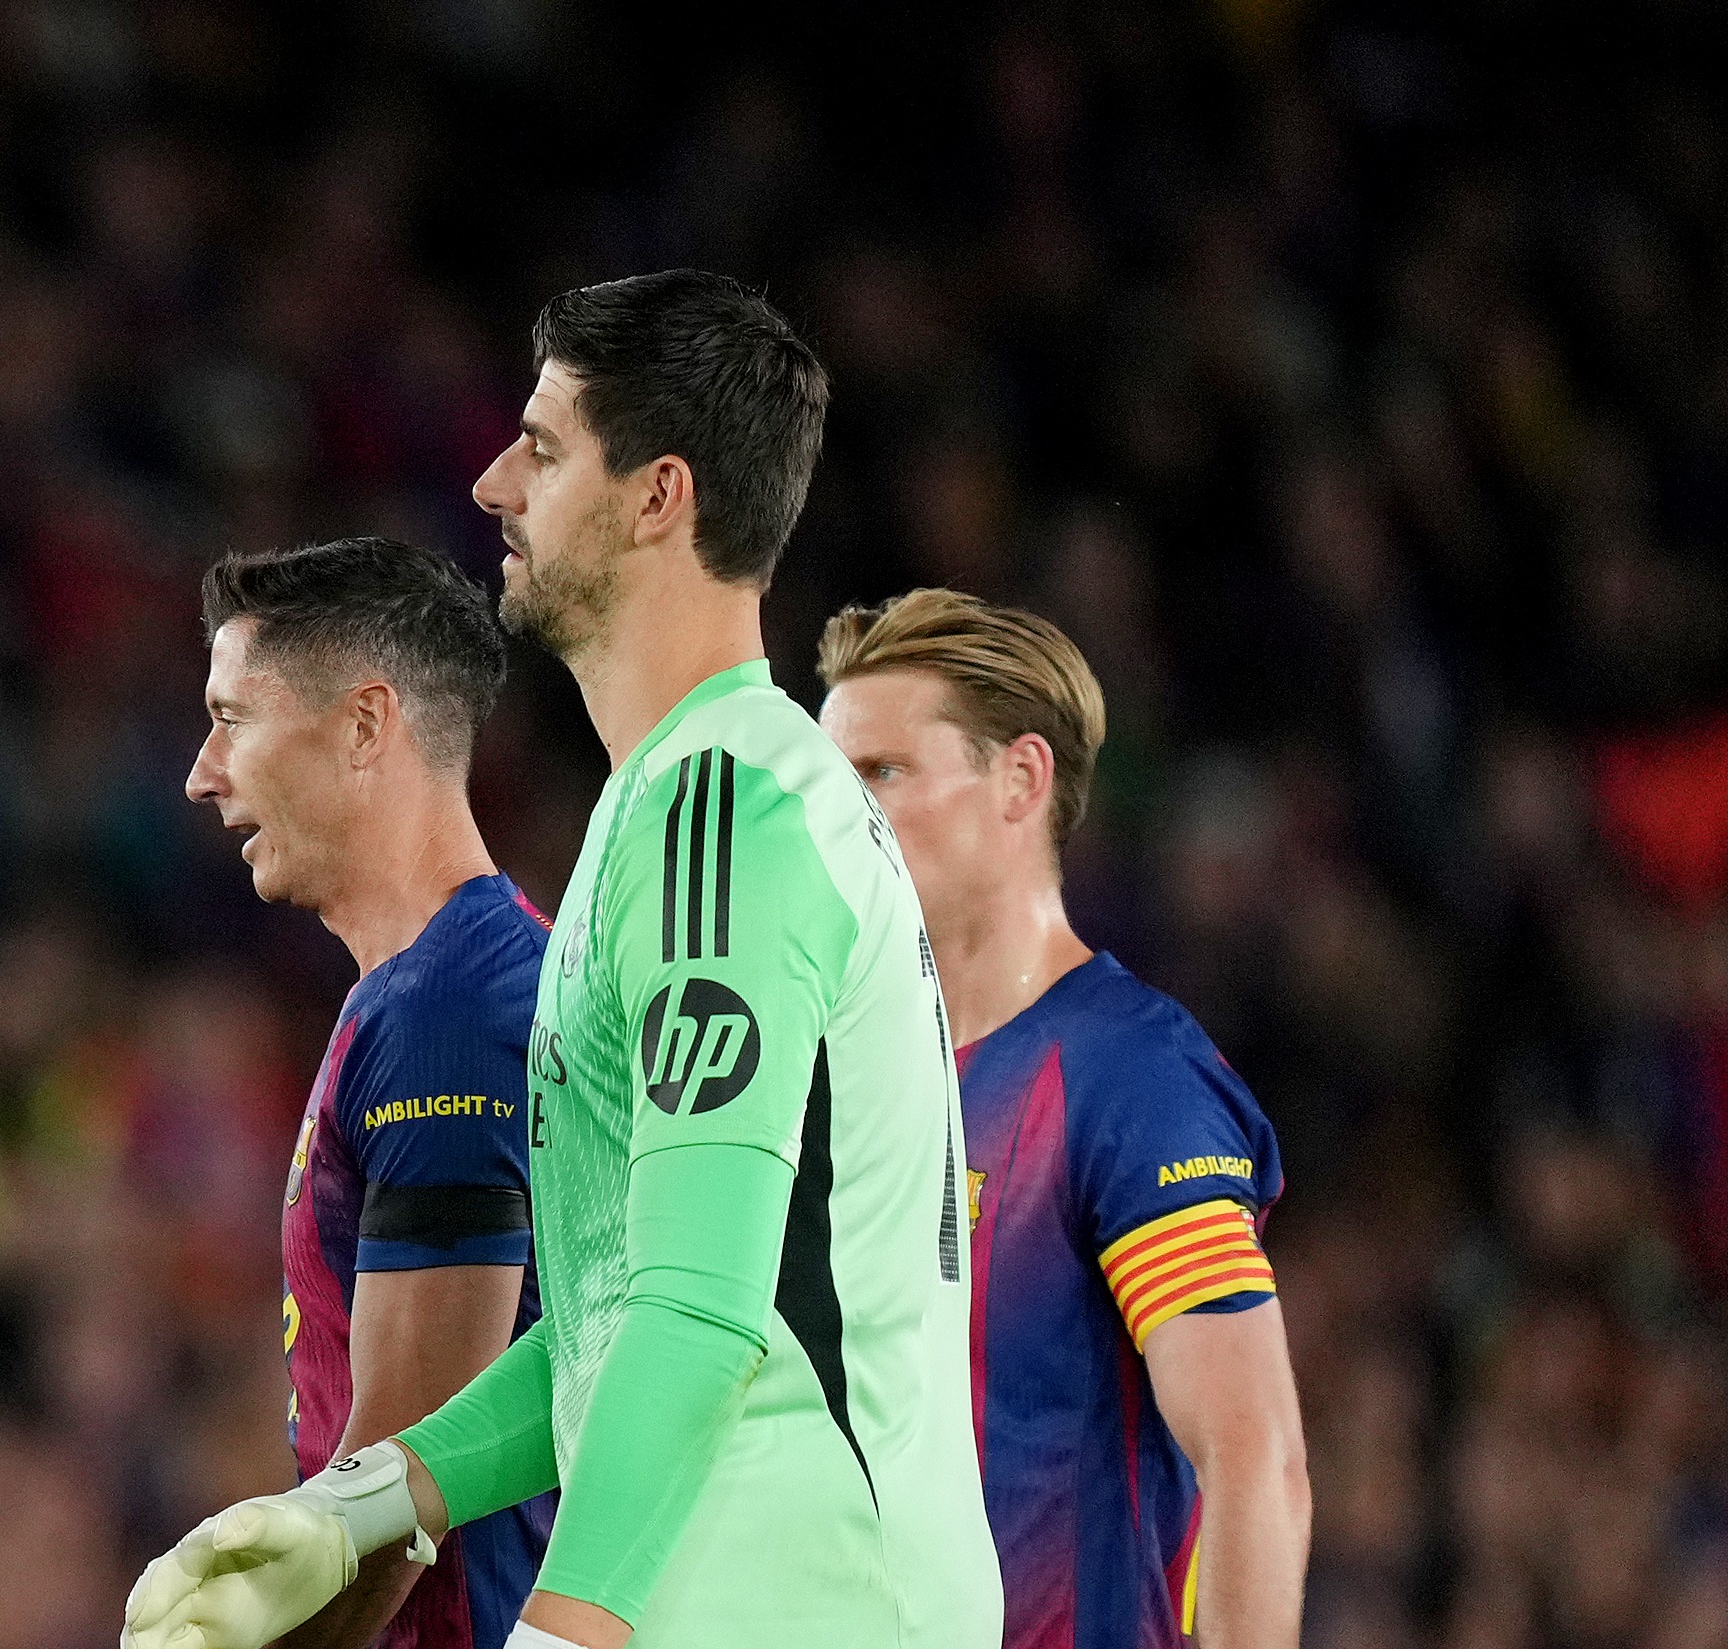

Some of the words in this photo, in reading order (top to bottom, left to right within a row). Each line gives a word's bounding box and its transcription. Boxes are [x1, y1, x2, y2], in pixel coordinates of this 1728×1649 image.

[649, 978, 757, 1114] hp
[365, 1095, 487, 1130] AMBILIGHT
[493, 1099, 515, 1118] tv
